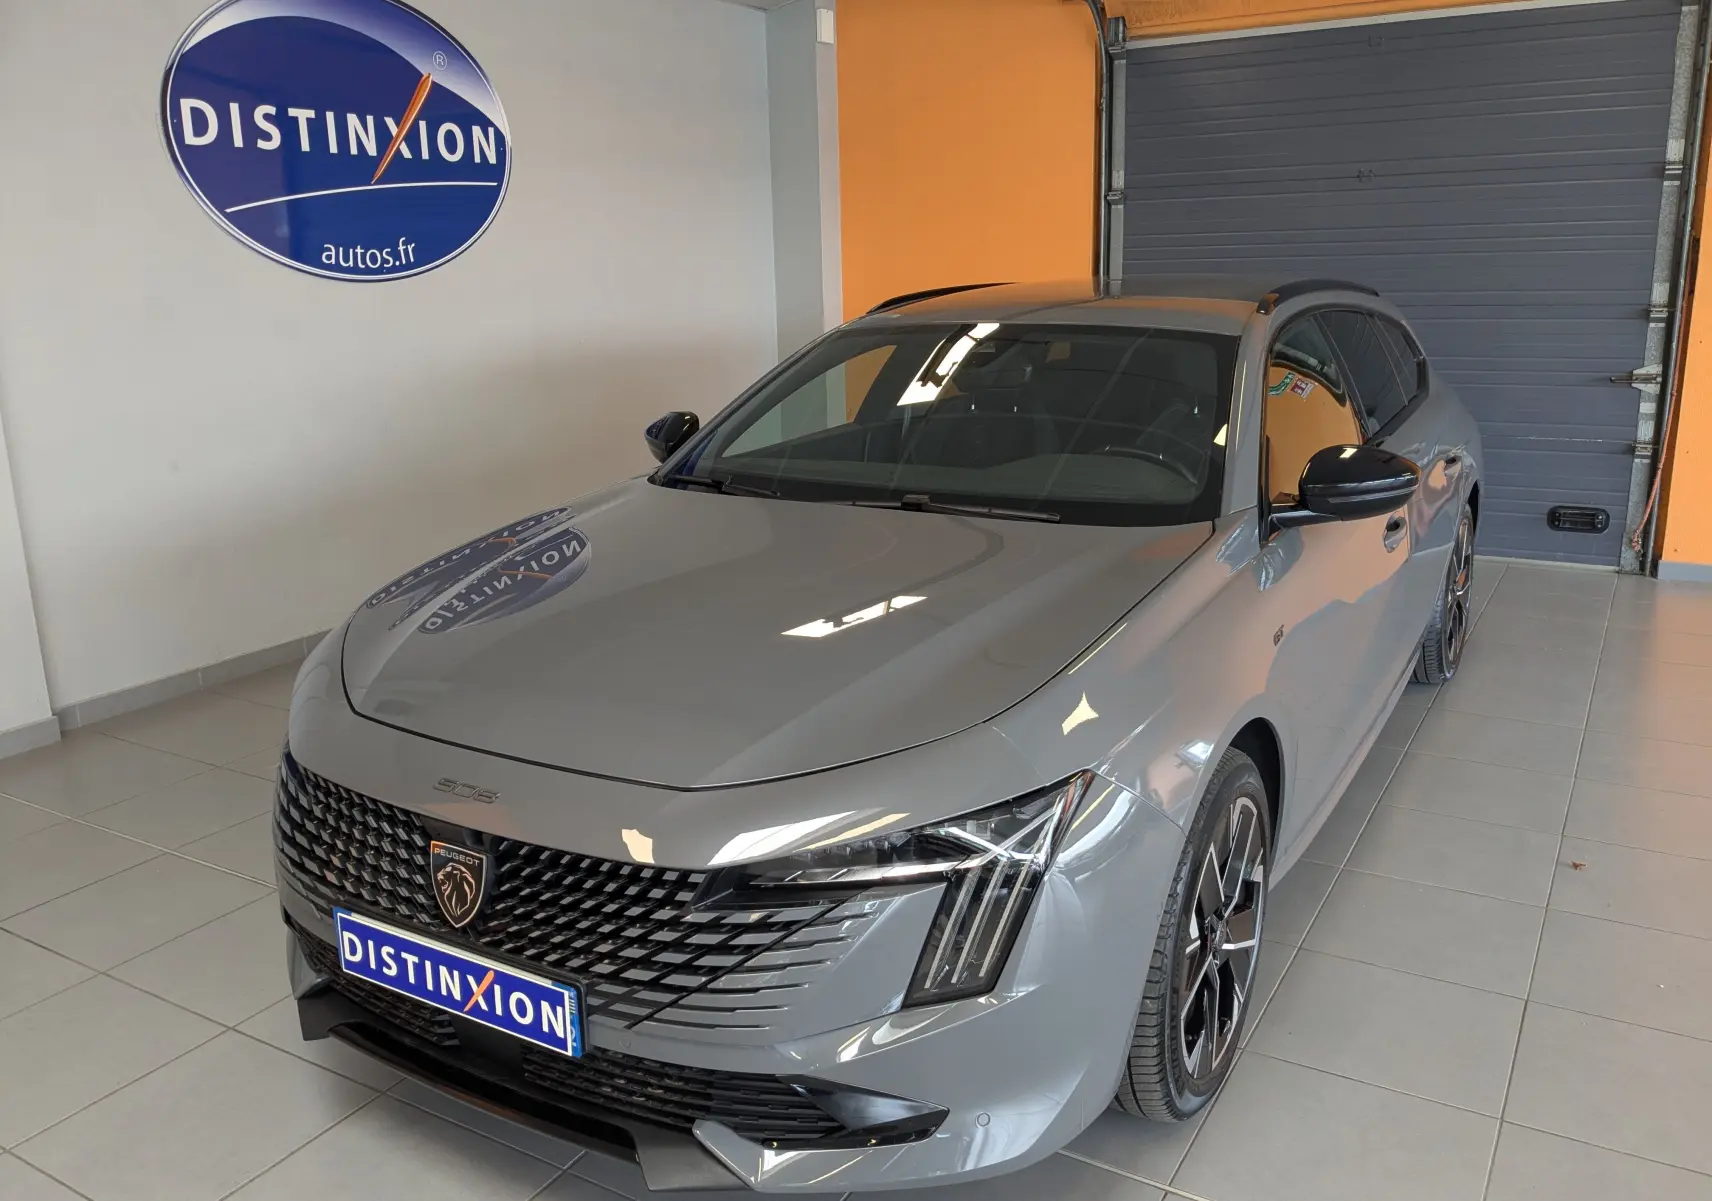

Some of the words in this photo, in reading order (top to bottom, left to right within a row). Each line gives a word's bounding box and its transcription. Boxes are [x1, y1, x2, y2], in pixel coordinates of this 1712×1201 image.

[180, 98, 497, 165] DISTINXION
[321, 237, 416, 269] autos.fr
[433, 777, 500, 804] 508
[434, 847, 480, 866] PEUGEOT
[342, 931, 565, 1039] DISTINXION
